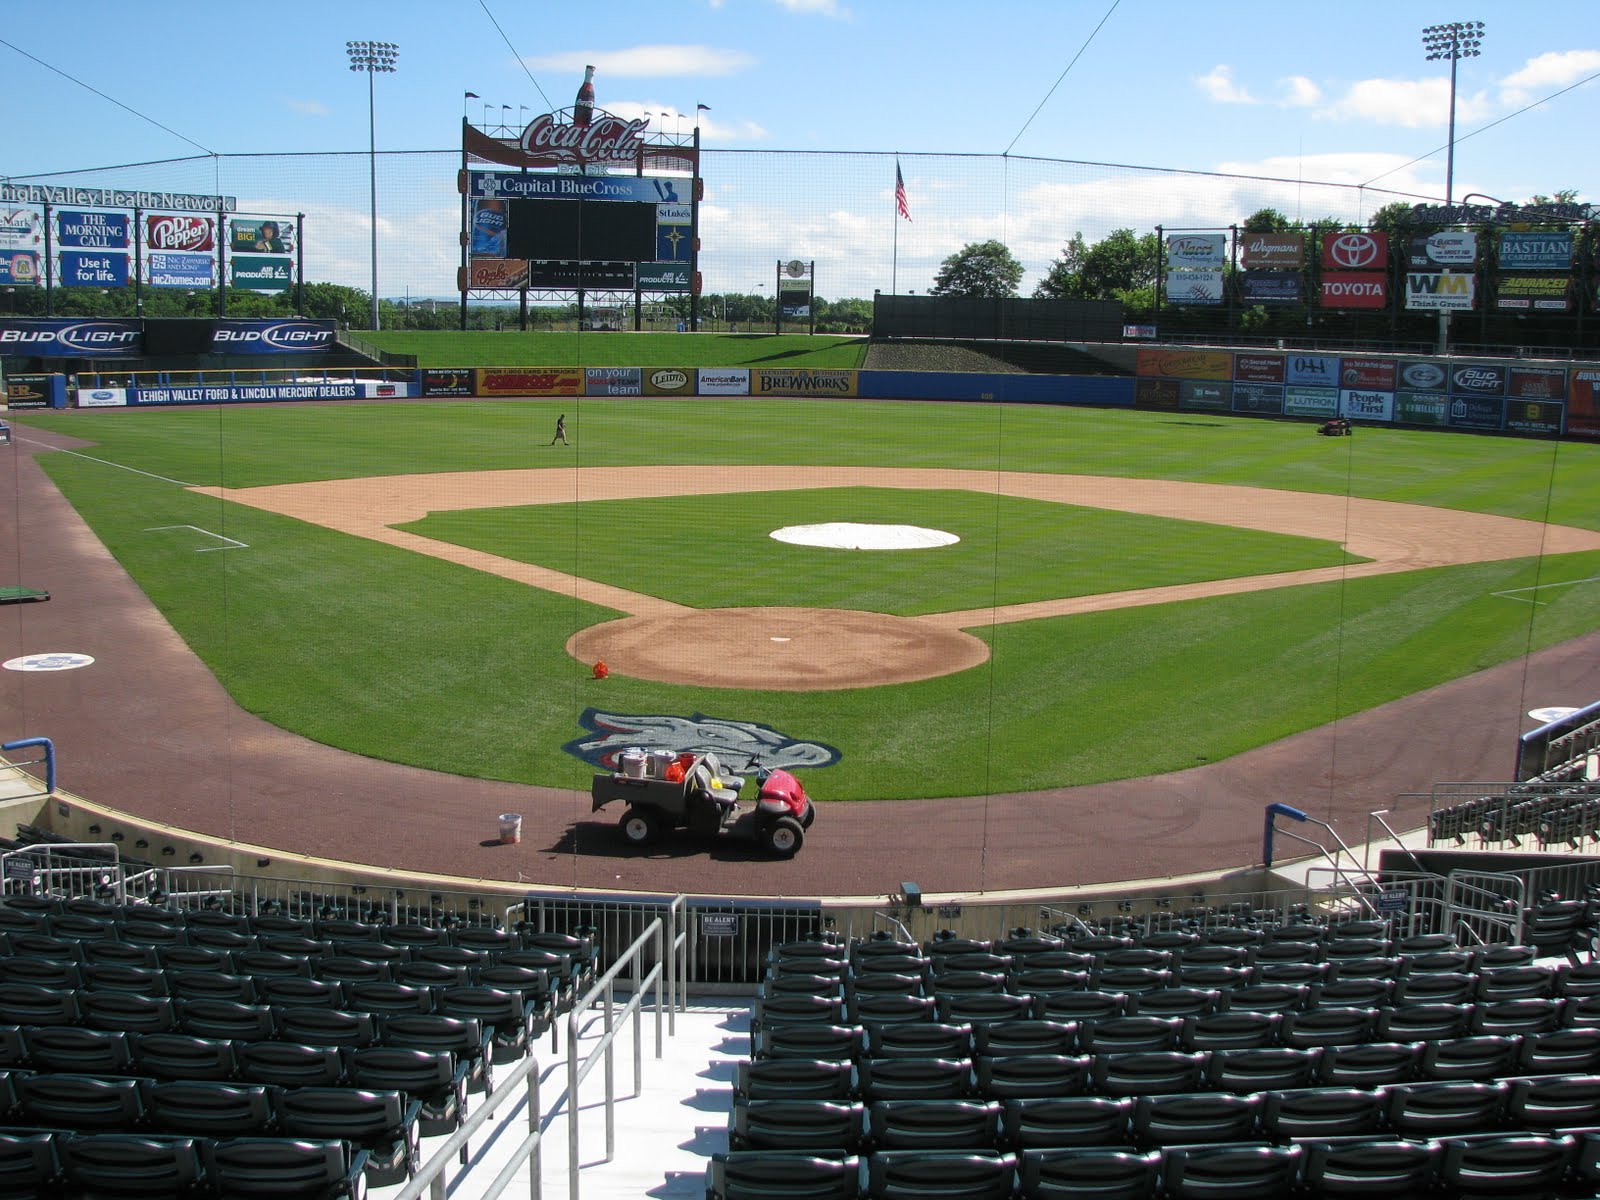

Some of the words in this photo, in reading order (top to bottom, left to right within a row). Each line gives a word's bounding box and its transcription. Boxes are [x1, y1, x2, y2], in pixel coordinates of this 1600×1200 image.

[522, 114, 649, 160] Coca-Cola
[558, 163, 610, 175] PARK
[502, 178, 556, 196] Capital
[560, 180, 633, 196] BlueCross
[43, 186, 98, 208] Valley
[102, 189, 158, 208] Health
[162, 192, 232, 210] Network
[80, 214, 107, 225] THE
[173, 217, 193, 231] Dr
[65, 224, 123, 237] MORNING
[160, 223, 206, 249] Pepper
[237, 232, 256, 241] BIG!
[79, 235, 112, 247] CALL
[1248, 237, 1298, 259] Wegmans
[1501, 241, 1569, 254] BASTIAN
[79, 257, 101, 269] Use
[102, 257, 111, 269] it
[77, 269, 96, 281] for
[97, 270, 117, 282] life.
[152, 274, 211, 286] nicZhomes.com
[236, 271, 274, 279] PRODUCTS
[1409, 275, 1468, 294] WM
[1506, 277, 1569, 287] ADVANCED
[1322, 282, 1383, 296] TOYOTA
[1498, 287, 1528, 295] BUSINESS
[1528, 288, 1566, 296] EQUIPMENT
[1411, 300, 1437, 308] Think
[1438, 300, 1471, 308] Green.
[0, 330, 56, 342] BUD
[69, 331, 141, 342] LIGHT
[213, 330, 262, 341] BUD
[271, 330, 333, 341] LIGHT
[587, 369, 602, 377] on
[606, 369, 631, 379] your
[700, 375, 747, 383] AmericanBank
[1464, 370, 1497, 380] BUD
[1459, 378, 1503, 388] LIGHT
[138, 390, 170, 402] LEHIGH
[172, 389, 204, 402] VALLEY
[205, 389, 229, 401] FORD
[231, 388, 238, 400] &
[240, 387, 277, 400] LINCOLN
[278, 387, 318, 399] MERCURY
[319, 385, 356, 398] DEALERS
[608, 385, 639, 394] team
[1293, 397, 1335, 407] LUTRON
[1348, 392, 1385, 404] People
[1359, 403, 1384, 414] First
